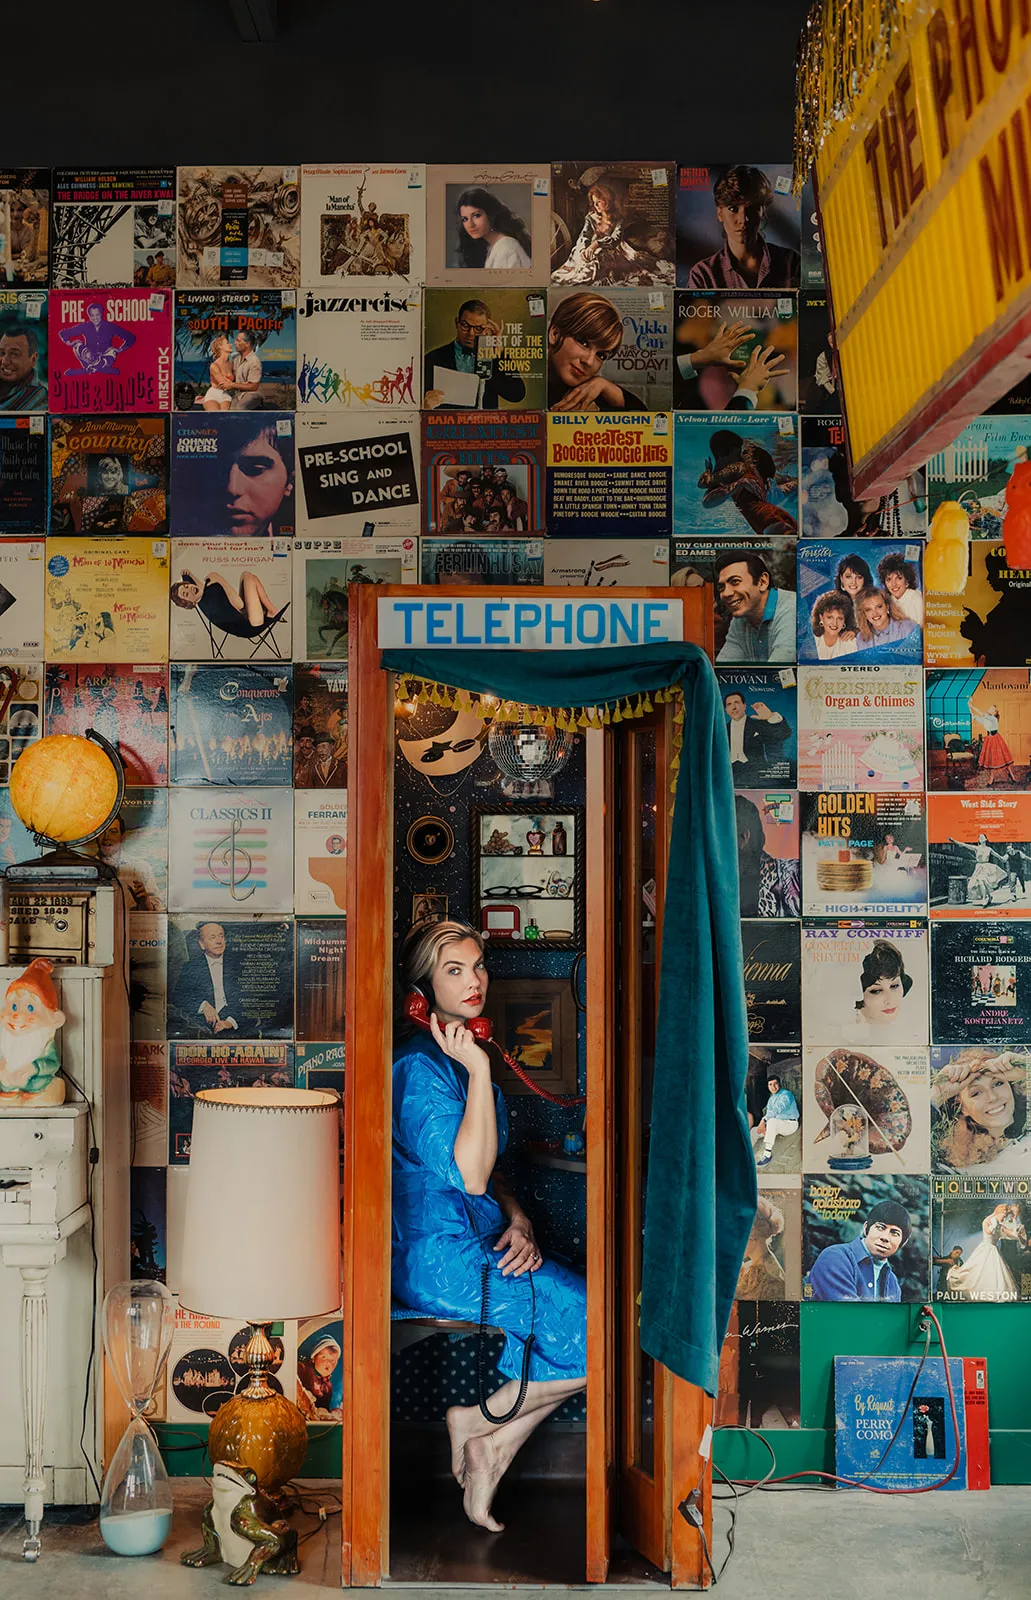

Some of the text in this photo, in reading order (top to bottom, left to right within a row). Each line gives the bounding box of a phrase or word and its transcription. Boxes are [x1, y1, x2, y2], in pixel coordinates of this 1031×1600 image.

[864, 62, 924, 250] THE
[57, 190, 174, 200] THE BRIDGE ON THE RIVER KWAI
[188, 294, 250, 303] LIVING STEREO
[61, 299, 154, 323] PRE SCHOOL
[678, 305, 721, 318] ROGER
[188, 315, 284, 331] SOUTH PACIFIC
[505, 323, 523, 335] THE
[622, 316, 668, 335] Vikki
[486, 335, 543, 347] BEST OF THE
[478, 347, 543, 360] STAN FREBERG
[498, 360, 531, 371] SHOWS
[612, 357, 669, 370] TODAY!
[427, 415, 539, 424] BAJA MARIMBA BAND
[552, 415, 651, 424] BILLY VAUGHN
[677, 415, 741, 423] Nelson Riddle
[80, 420, 142, 435] Anne Murray
[426, 425, 541, 439] GREATEST
[178, 438, 218, 446] JOHNNY
[984, 432, 1007, 442] Film
[176, 445, 218, 453] RIVERS
[303, 441, 408, 468] PRE-SCHOOL
[459, 451, 510, 465] HITS
[320, 468, 393, 488] SING AND
[351, 483, 411, 505] DANCE
[294, 541, 342, 550] SUPPE
[72, 556, 92, 567] Man
[112, 557, 145, 570] Mancha
[434, 553, 543, 575] FERLIN HUSKY
[551, 567, 586, 575] Armstrong
[393, 603, 669, 645] TELEPHONE
[219, 681, 280, 701] Conquerors
[980, 681, 1030, 690] Mantovani
[825, 696, 916, 710] Organ & Chimes
[240, 704, 273, 728] Ages
[817, 793, 875, 814] GOLDEN
[960, 800, 1018, 808] West Side Story
[190, 808, 272, 820] CLASSICS II
[818, 817, 851, 837] HITS
[12, 896, 30, 906] AUG
[34, 896, 47, 906] 22
[44, 907, 69, 915] 1849
[804, 930, 925, 938] RAY CONNIFF
[804, 940, 870, 951] CONCERT IN
[812, 953, 860, 963] RHYTHM
[954, 955, 993, 963] RICHARD
[979, 1010, 1009, 1018] ANDRE
[178, 1045, 285, 1058] DON HO-AGAIN!
[297, 1052, 324, 1079] PIANO
[809, 1184, 842, 1198] bobby
[812, 1196, 862, 1210] goldsboro
[936, 1290, 1018, 1301] PAUL WESTON
[180, 1320, 221, 1329] THE ROUND
[854, 1393, 895, 1416] By Request
[855, 1419, 894, 1430] PERRY
[856, 1430, 894, 1441] COMO
